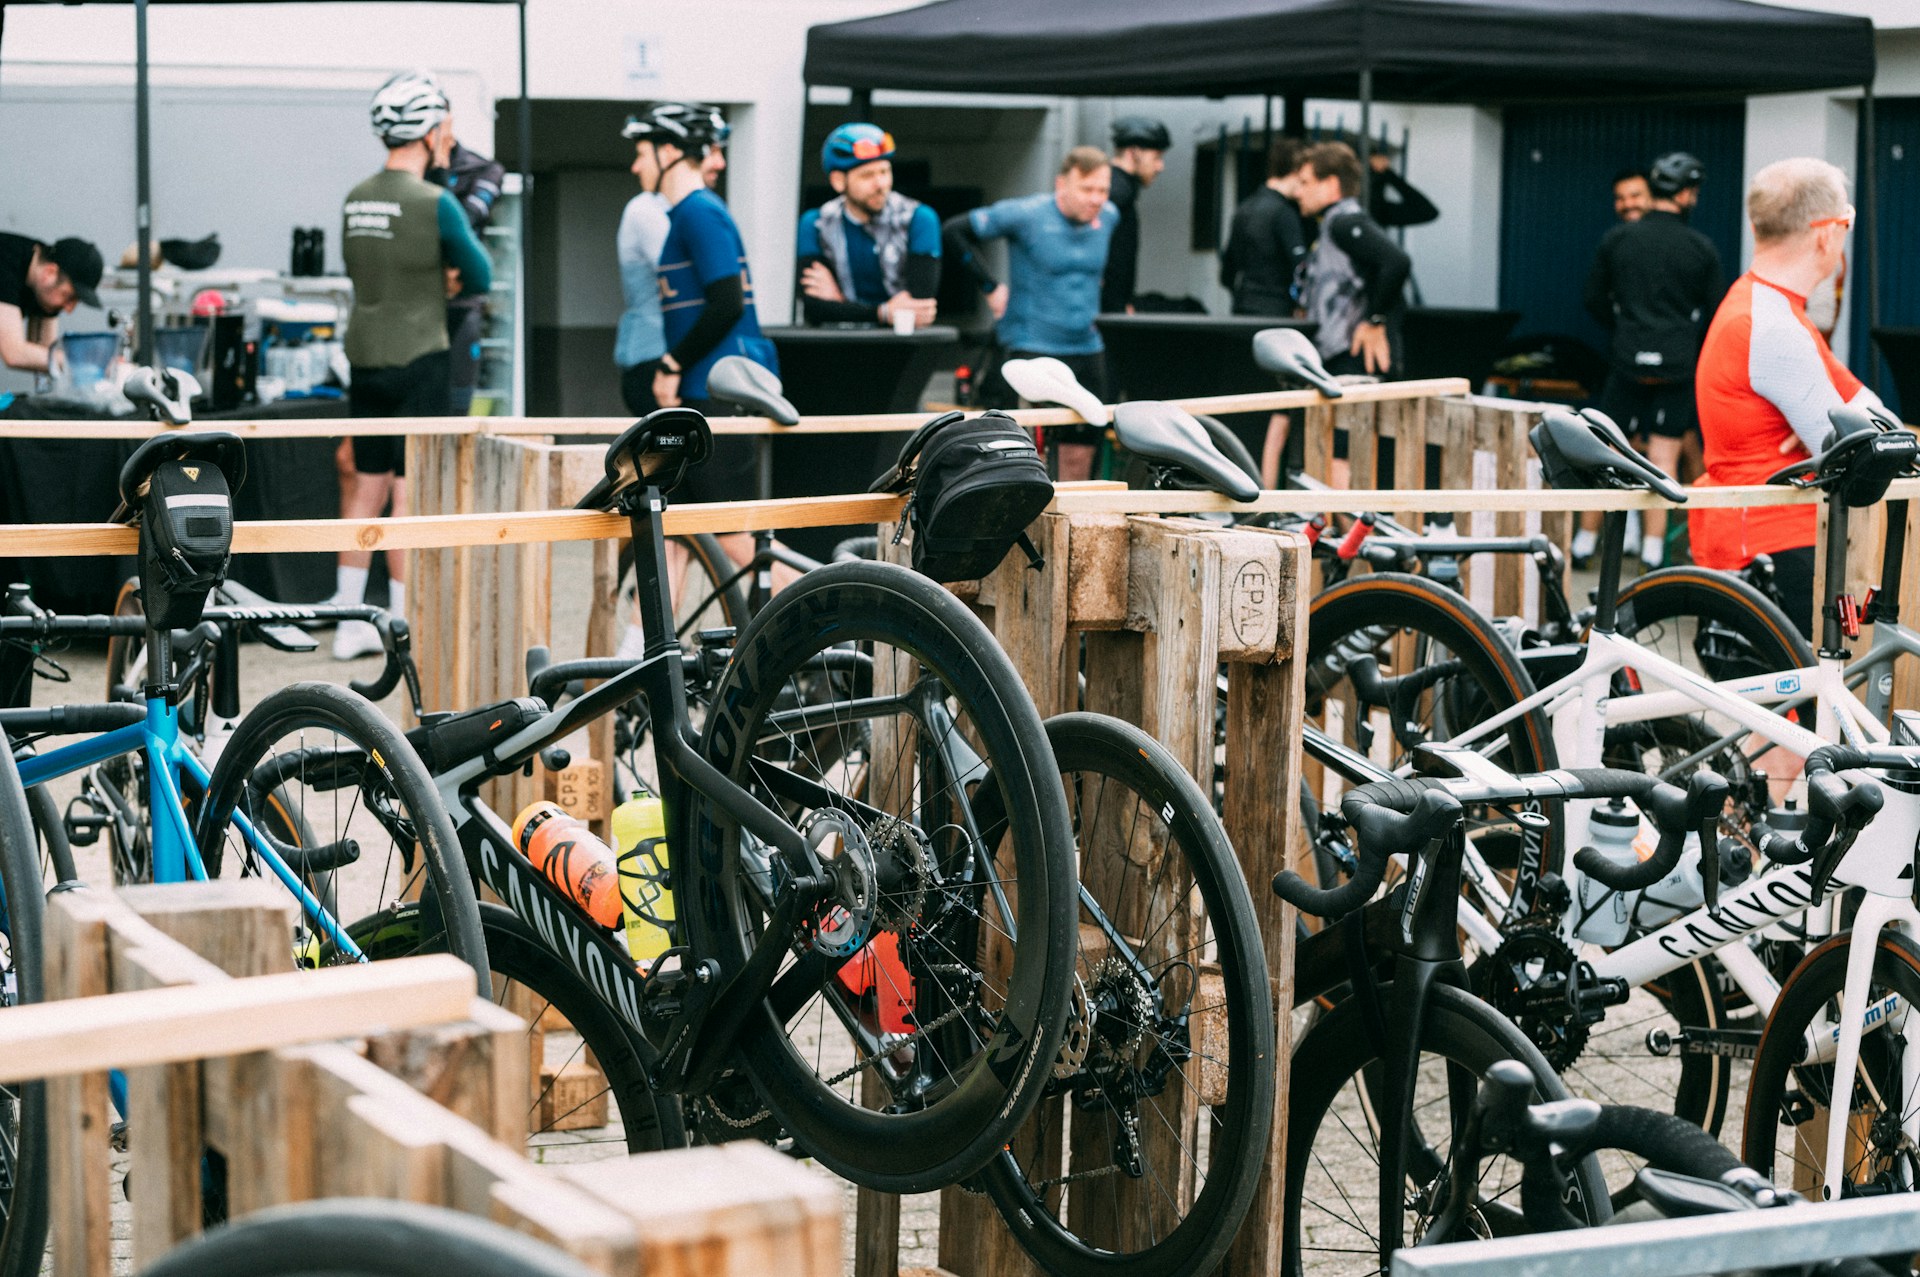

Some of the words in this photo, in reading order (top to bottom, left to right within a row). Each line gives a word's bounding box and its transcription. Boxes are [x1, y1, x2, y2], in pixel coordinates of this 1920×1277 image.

[1240, 573, 1265, 636] EPAL
[698, 589, 841, 932] REYNODS
[479, 837, 650, 1041] CANYON
[1000, 1024, 1044, 1119] CONTINENTAL
